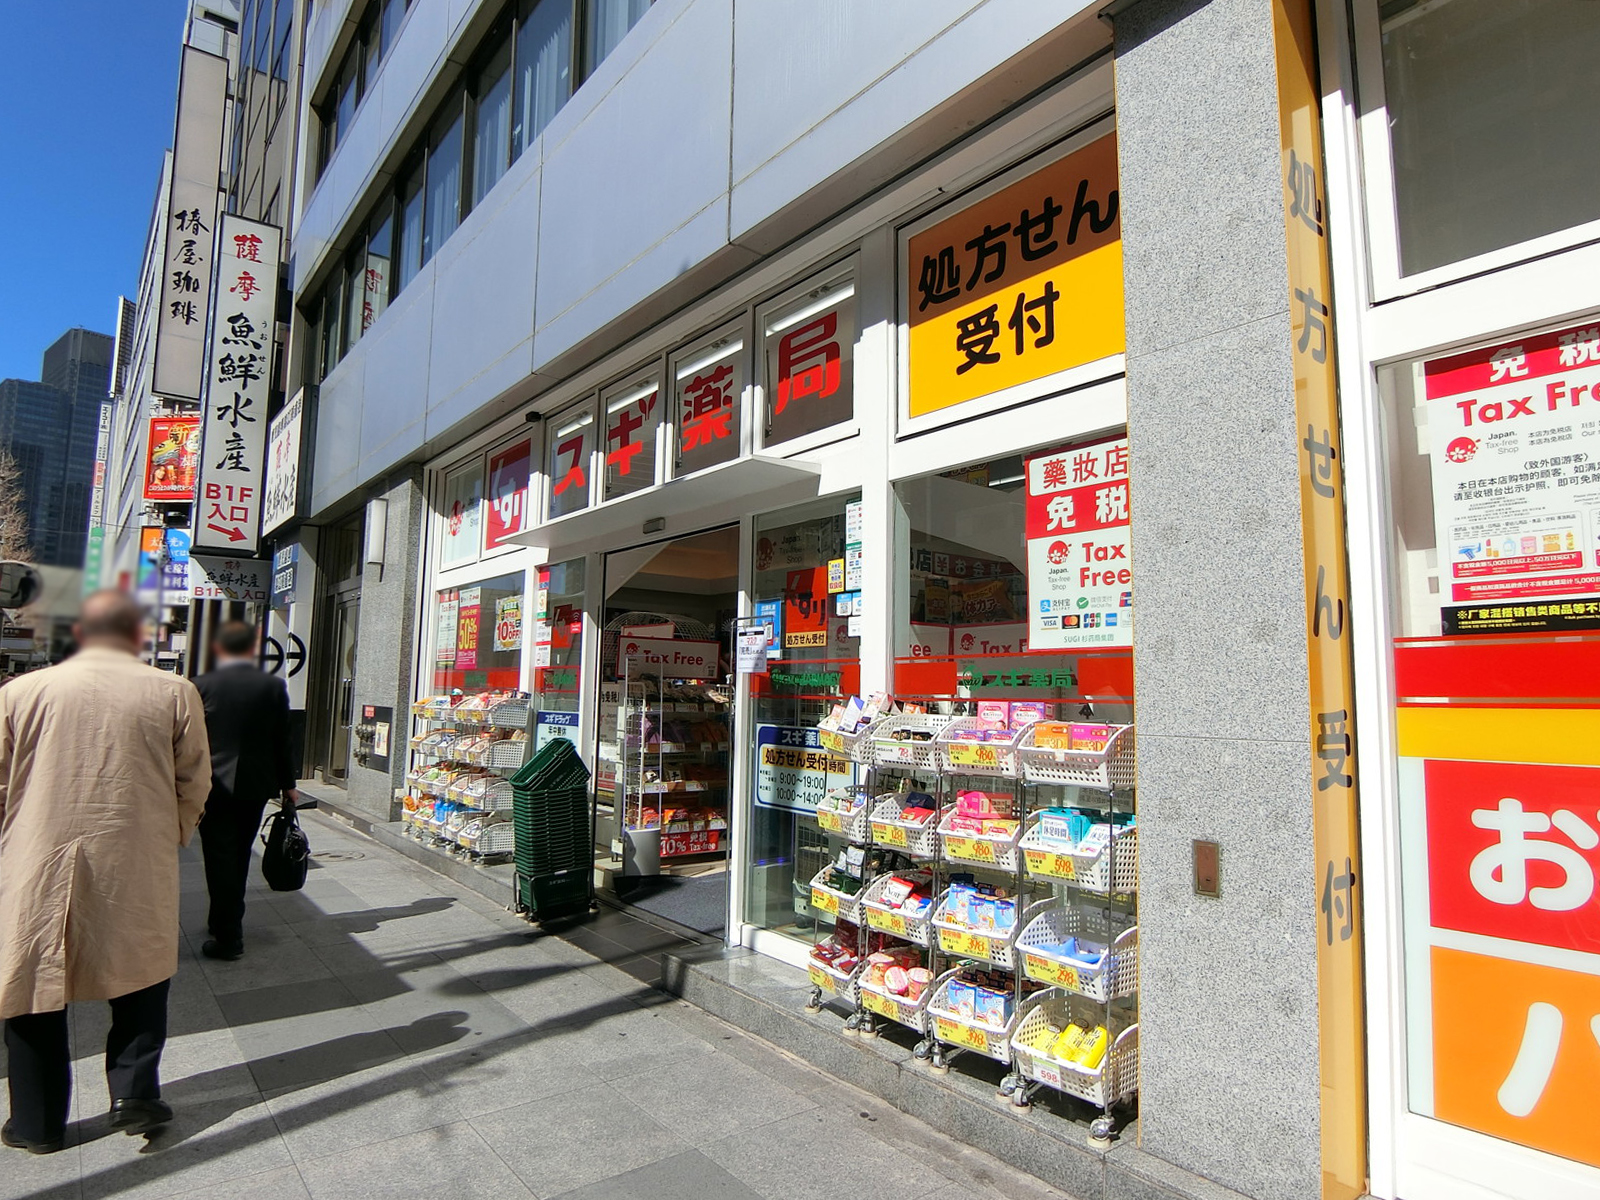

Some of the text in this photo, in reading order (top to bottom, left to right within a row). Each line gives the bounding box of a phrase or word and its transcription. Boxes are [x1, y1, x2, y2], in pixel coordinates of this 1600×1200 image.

[918, 178, 1120, 312] 処方せん
[170, 207, 210, 325] 椿屋珈琲
[229, 233, 263, 302] 薩摩
[956, 280, 1060, 376] 受付
[216, 311, 262, 473] 魚鮮水産
[553, 311, 841, 497] スギ薬局
[1456, 395, 1536, 428] Tax
[1498, 446, 1519, 455] Shop
[1043, 445, 1128, 489] 藥妝店
[205, 482, 253, 503] B1F
[207, 503, 249, 523] 入口
[1046, 484, 1129, 531] 免税
[1082, 542, 1126, 563] Tax
[1287, 148, 1356, 946] 処方せん受付
[1080, 567, 1131, 588] Free
[194, 586, 223, 597] B1F
[242, 590, 266, 600] 入口
[786, 633, 825, 646] 処方せん受付
[1064, 635, 1080, 643] SUGI
[643, 649, 704, 665] Tax Free
[986, 667, 1072, 689] スギ薬局
[782, 729, 820, 747] スギ薬
[1470, 798, 1600, 912] お
[1054, 859, 1072, 873] 598
[1040, 1070, 1057, 1082] 598
